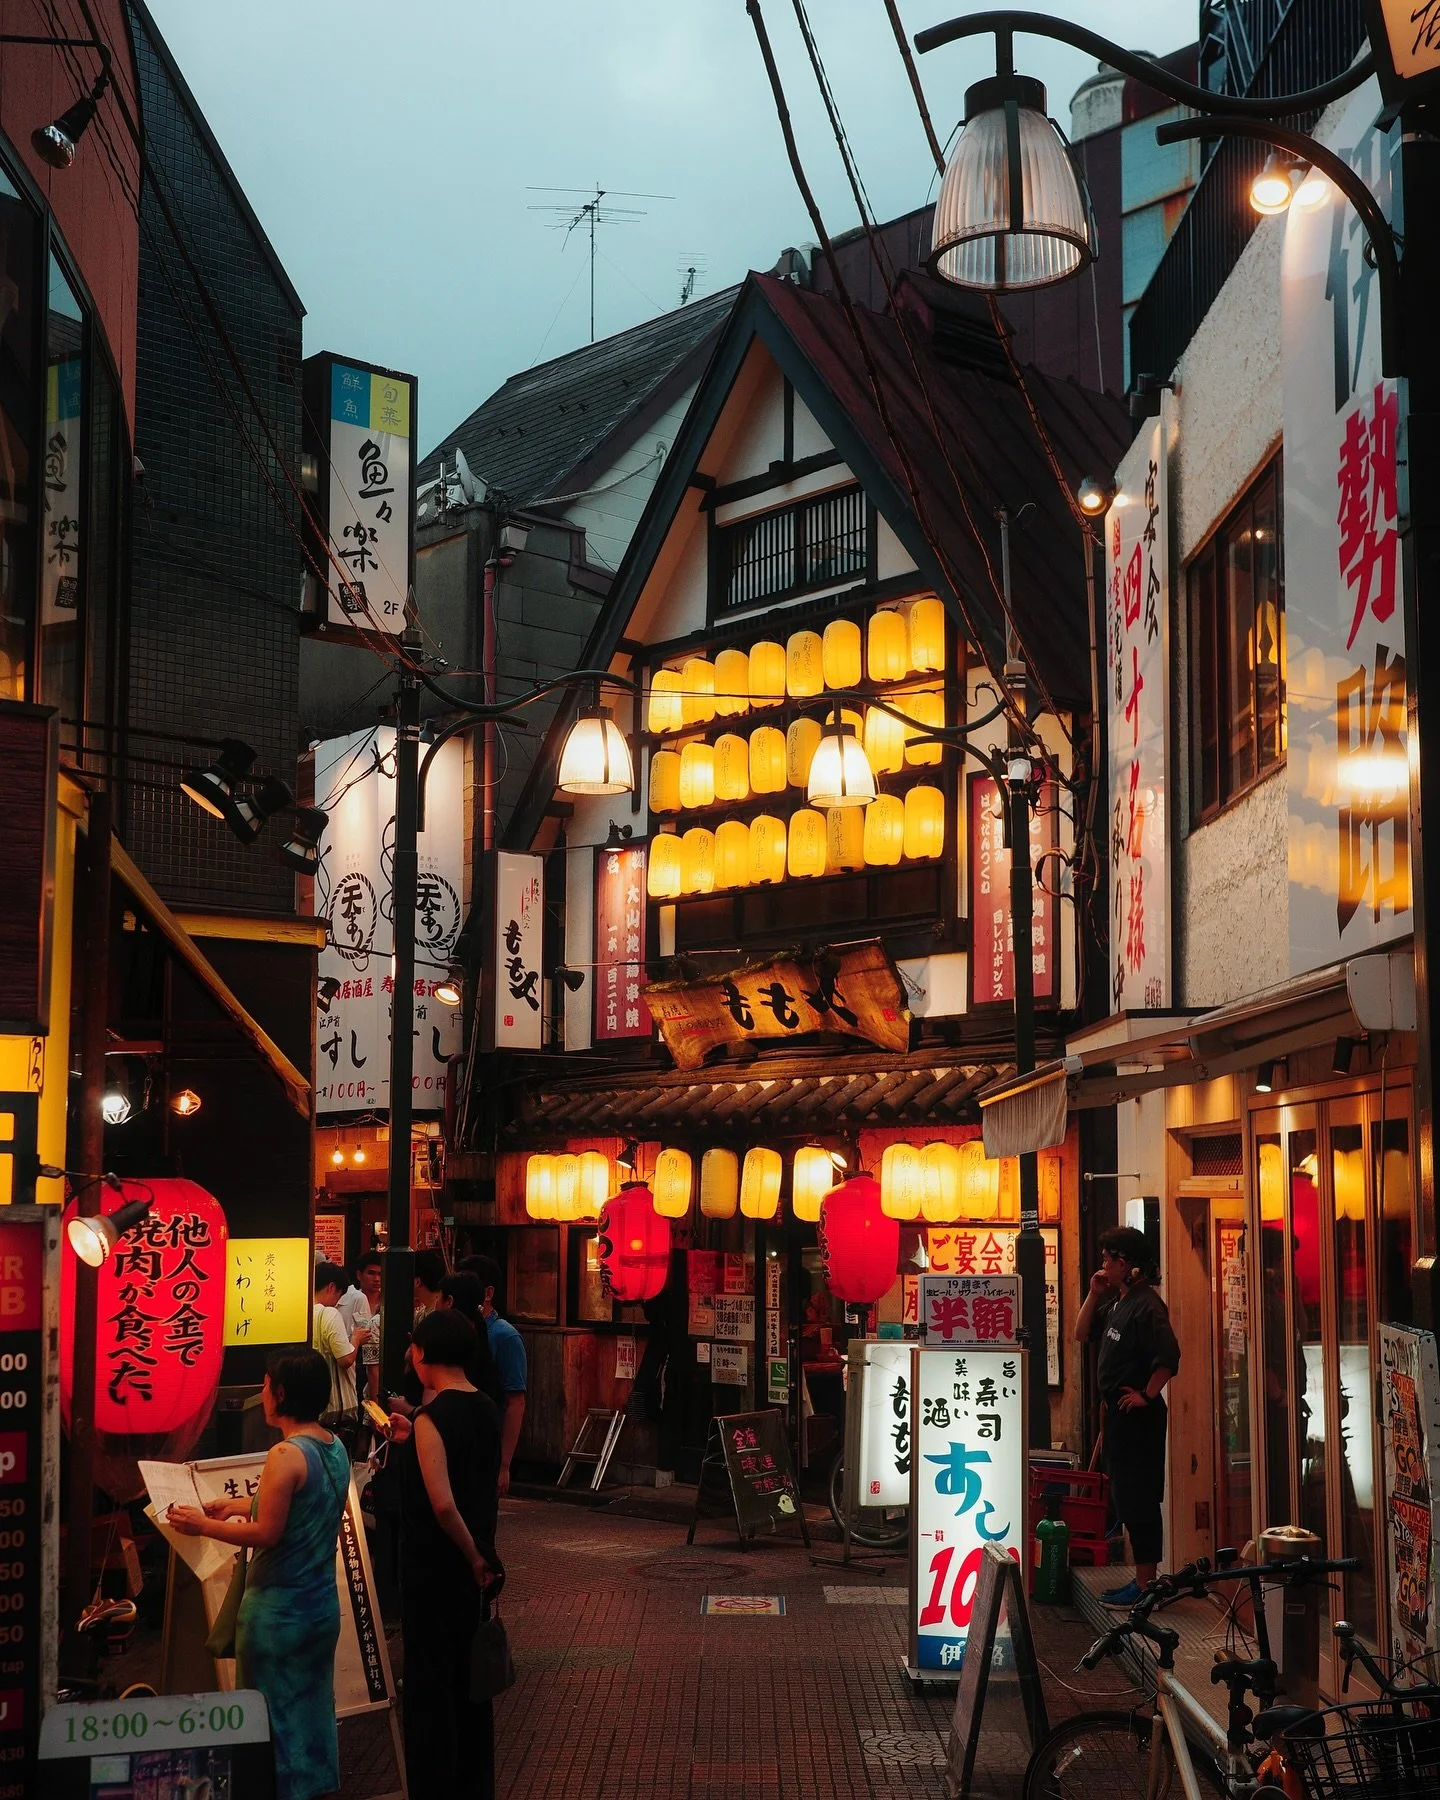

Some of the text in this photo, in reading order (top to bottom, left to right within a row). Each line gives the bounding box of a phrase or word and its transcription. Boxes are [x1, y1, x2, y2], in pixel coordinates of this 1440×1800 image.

[341, 372, 363, 418] 鮮魚
[381, 384, 401, 426] 旬菜
[383, 600, 399, 615] 2F
[502, 919, 540, 1011] ももや
[321, 1030, 367, 1071] すし
[931, 1232, 1003, 1274] ご宴会
[162, 1215, 211, 1366] 他人の金で
[234, 1255, 253, 1338] いわしげ
[264, 1253, 277, 1313] 炭火焼肉
[928, 1296, 1015, 1339] 半額
[953, 1358, 970, 1419] 美味い
[1002, 1360, 1016, 1398] 旨い
[923, 1398, 951, 1429] 酒
[975, 1377, 1001, 1441] 寿司
[923, 1441, 1011, 1541] すし
[342, 1510, 381, 1690] A5と名物厚切りタンがお値打ち
